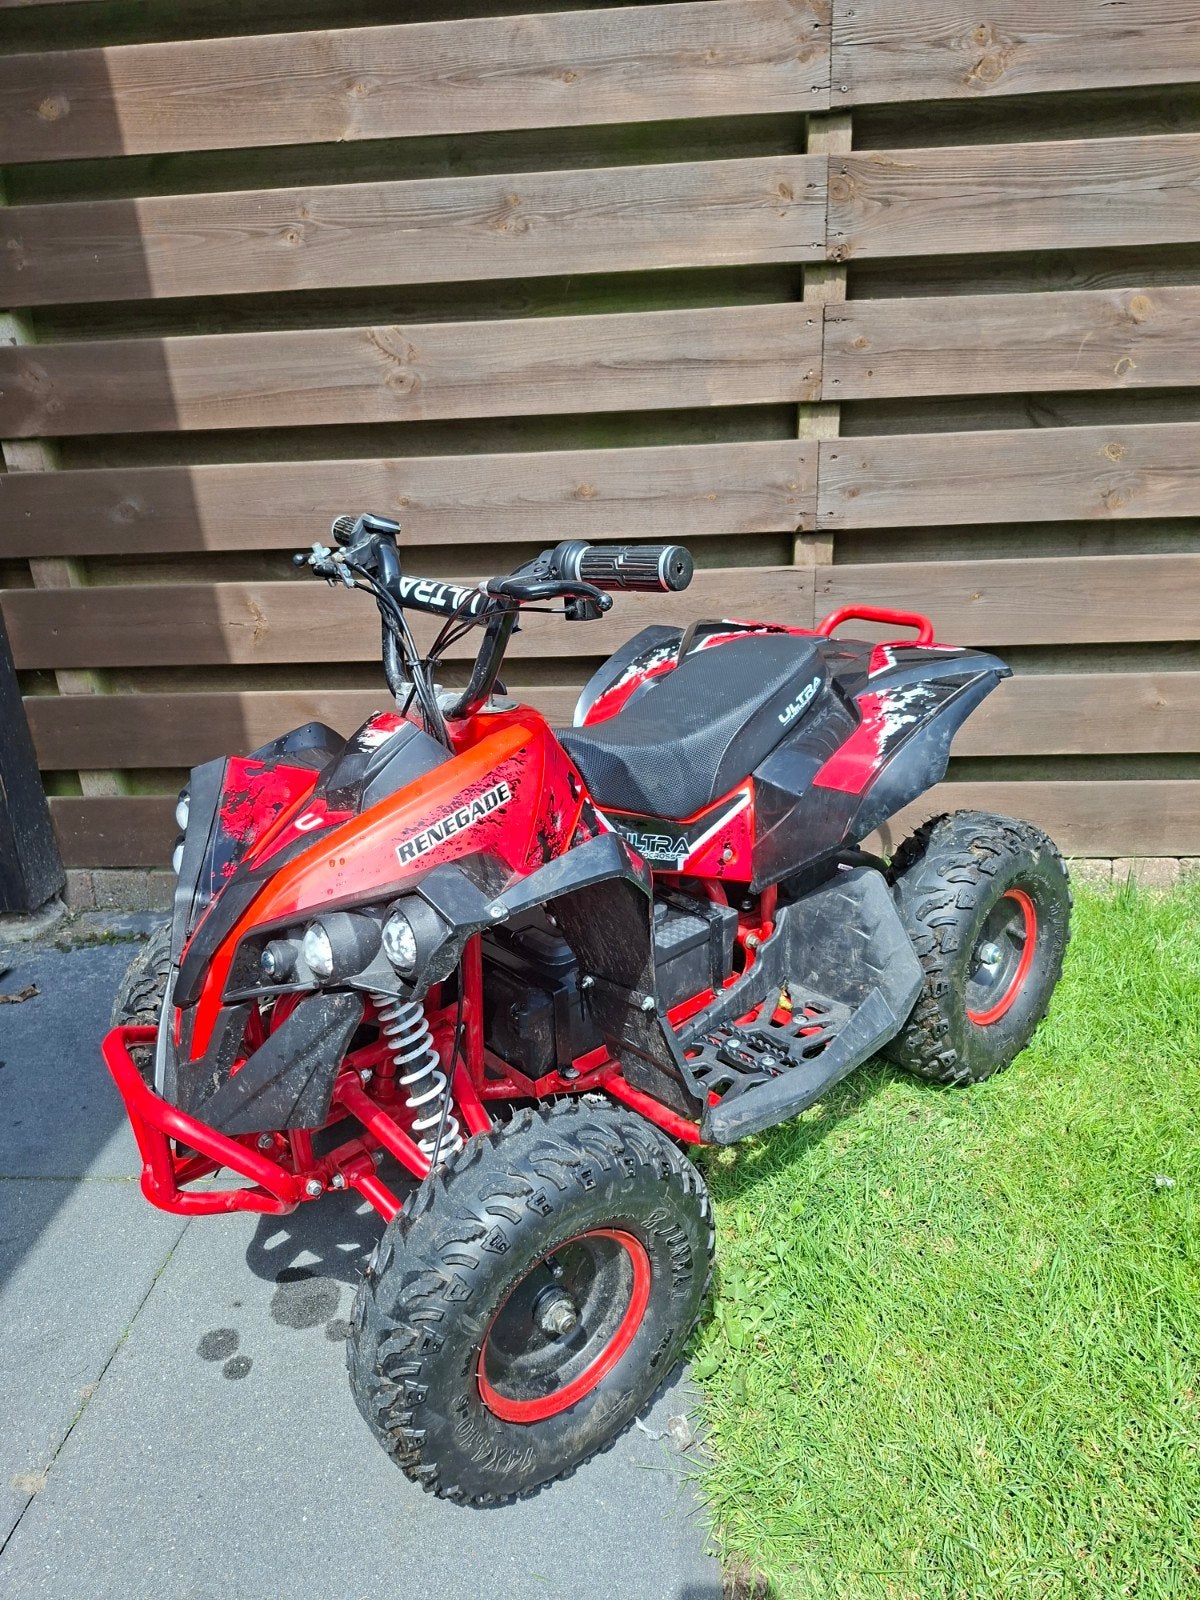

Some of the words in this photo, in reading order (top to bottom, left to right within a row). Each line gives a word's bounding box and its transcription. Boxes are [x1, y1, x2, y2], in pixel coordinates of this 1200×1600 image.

[400, 576, 481, 614] ULTRA
[778, 676, 821, 723] ULTRA
[296, 813, 324, 831] U
[397, 781, 511, 864] RENEGADE
